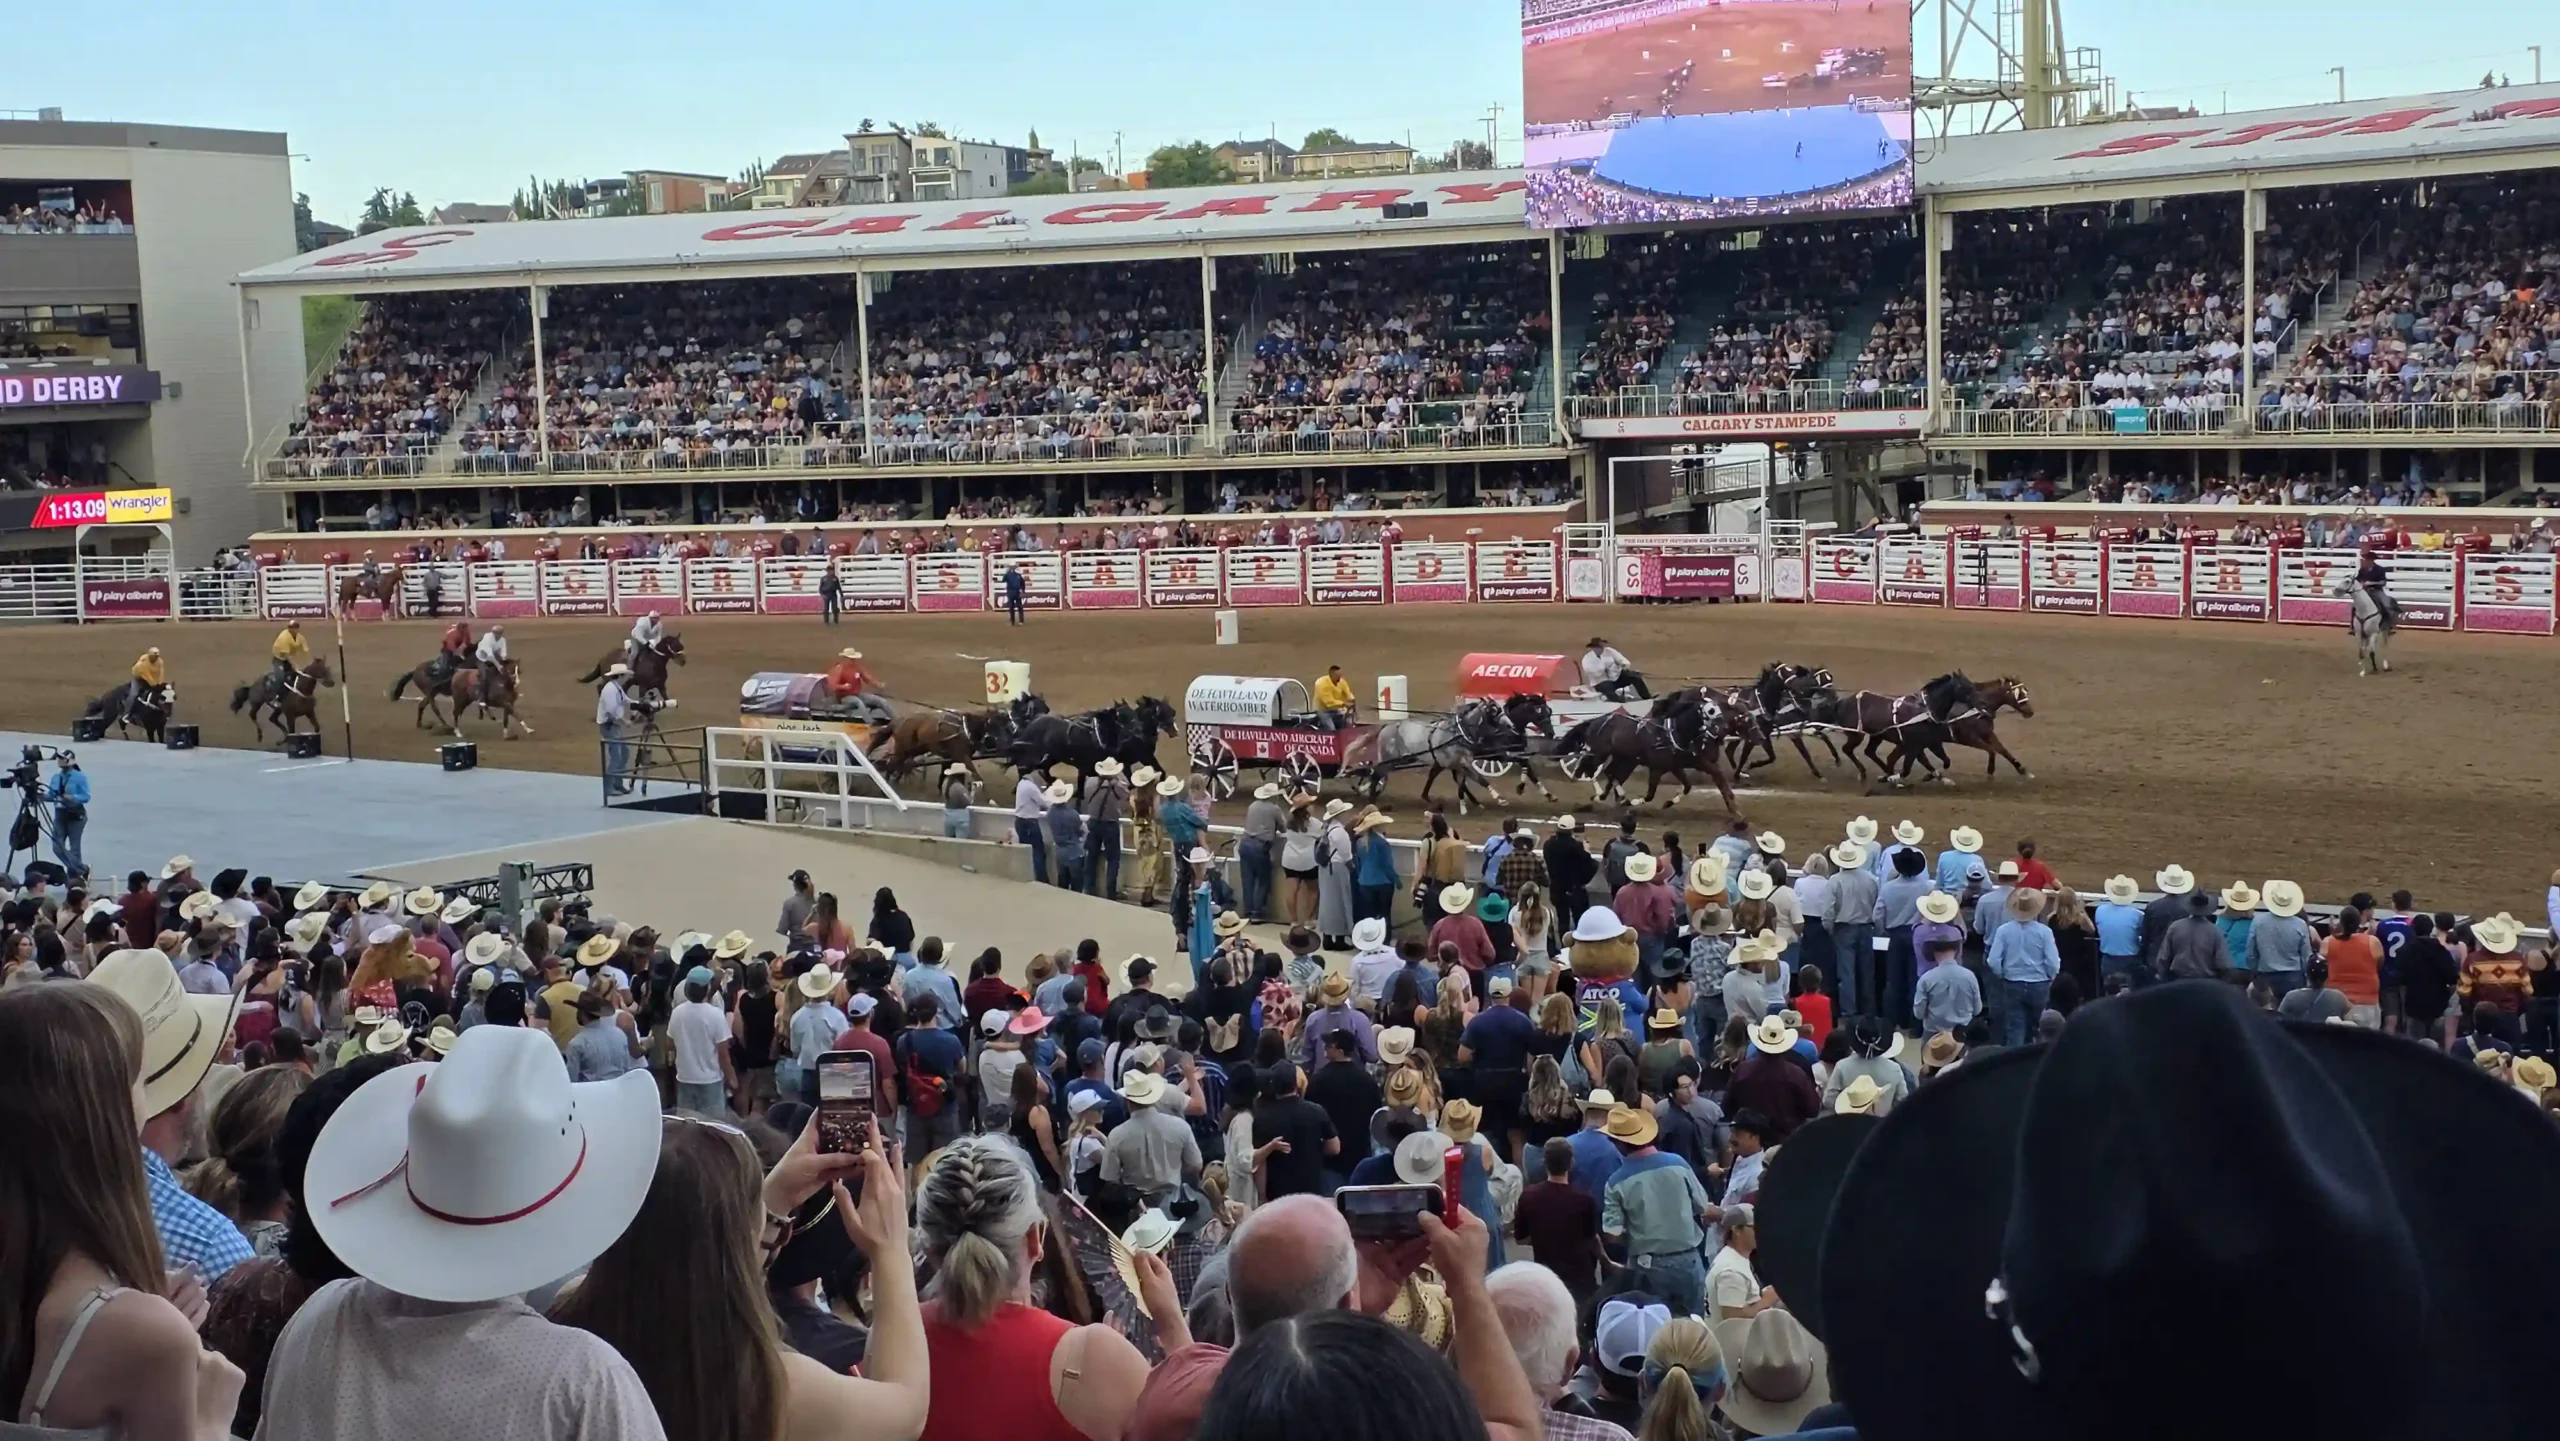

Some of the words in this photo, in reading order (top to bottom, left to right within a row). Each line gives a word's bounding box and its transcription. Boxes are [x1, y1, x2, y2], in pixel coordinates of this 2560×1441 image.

[702, 181, 1526, 241] CALGARY
[0, 379, 23, 404] D
[33, 375, 123, 402] DERBY
[1682, 418, 1751, 431] CALGARY
[1755, 416, 1836, 429] STAMPEDE
[49, 499, 105, 520] 1:13.09
[109, 495, 168, 514] Wrangler
[1677, 567, 1697, 577] play
[1697, 567, 1730, 576] alberta
[103, 591, 126, 602] play
[126, 591, 164, 601] alberta
[1165, 592, 1185, 602] play
[1185, 592, 1215, 601] alberta
[1328, 590, 1346, 599] play
[1347, 589, 1378, 598] alberta
[1496, 588, 1515, 597] play
[1516, 587, 1547, 596] alberta
[2045, 597, 2064, 607] play
[2064, 597, 2094, 606] alberta
[2208, 602, 2228, 614] play
[2228, 602, 2260, 613] alberta
[1471, 664, 1538, 678] AECON
[986, 672, 1000, 694] 3
[1191, 689, 1207, 700] DE
[1207, 689, 1267, 701] HAVILLAND
[1380, 686, 1391, 710] 1
[1188, 700, 1267, 714] WATERBOMBER
[1224, 729, 1238, 740] DE
[1238, 730, 1288, 743] HAVILLAND
[1290, 733, 1334, 745] AIRCRAFT
[1297, 745, 1335, 756] CANADA
[1582, 987, 1621, 1001] ATCO
